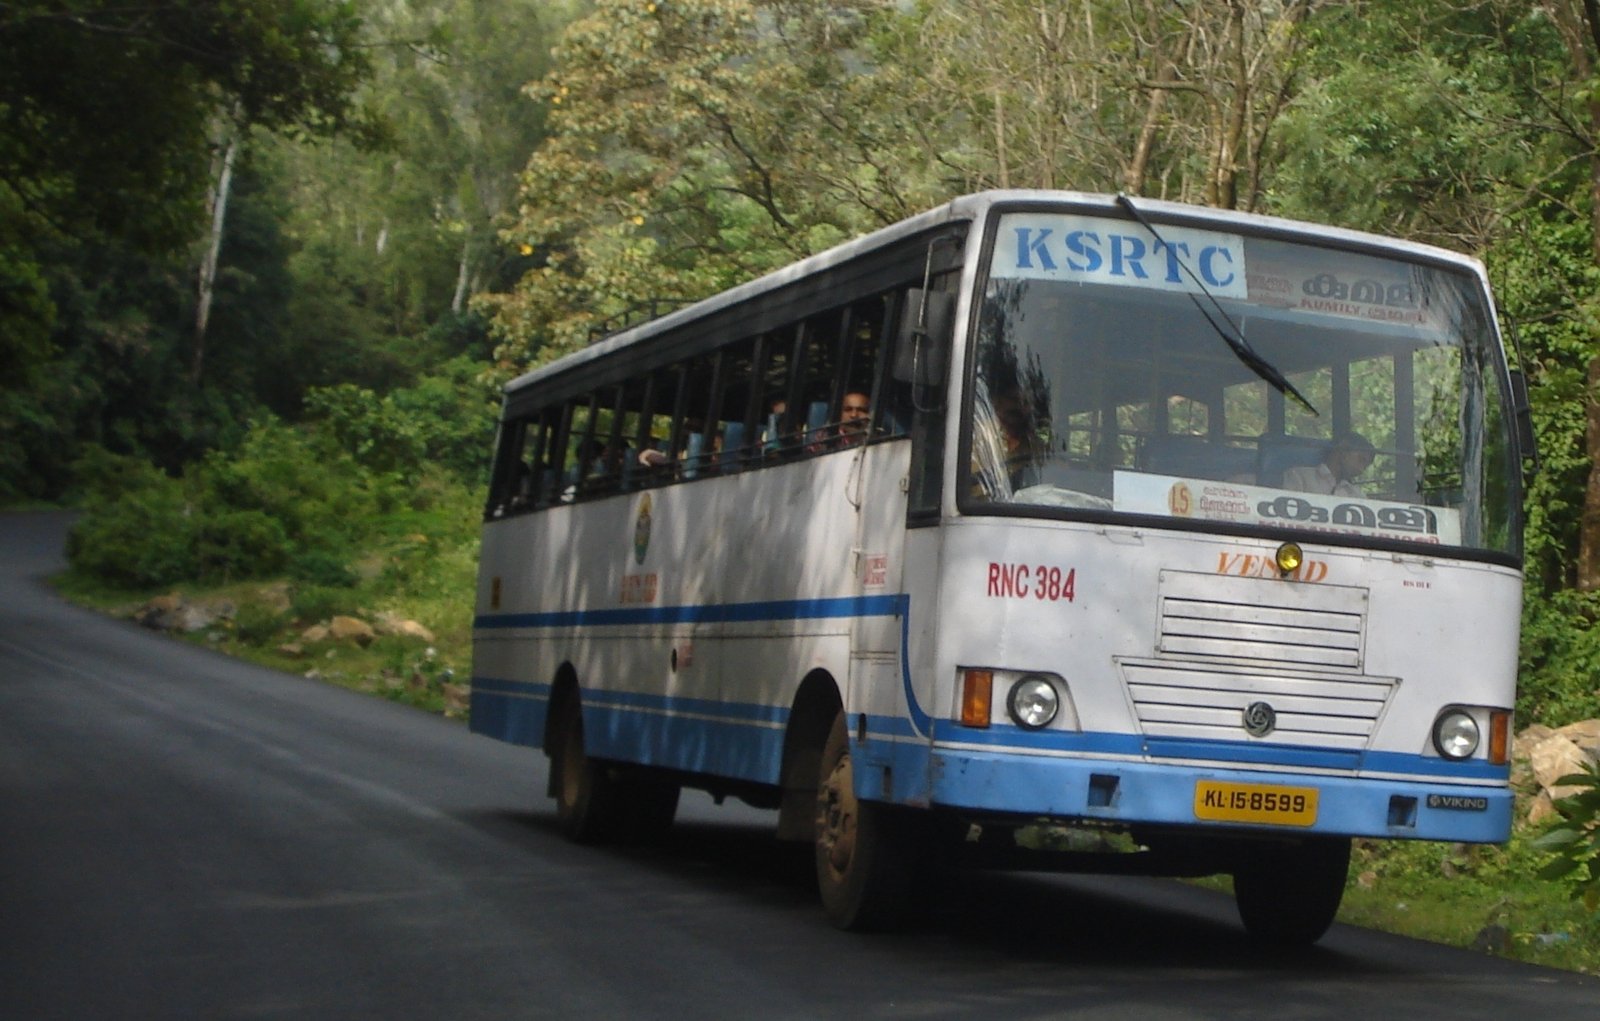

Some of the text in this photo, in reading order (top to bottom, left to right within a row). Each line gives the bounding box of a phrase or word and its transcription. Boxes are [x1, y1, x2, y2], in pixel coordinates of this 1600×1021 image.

[1014, 228, 1235, 287] KSRTC
[1301, 299, 1361, 316] KUMILY
[987, 562, 1076, 603] RNC 384
